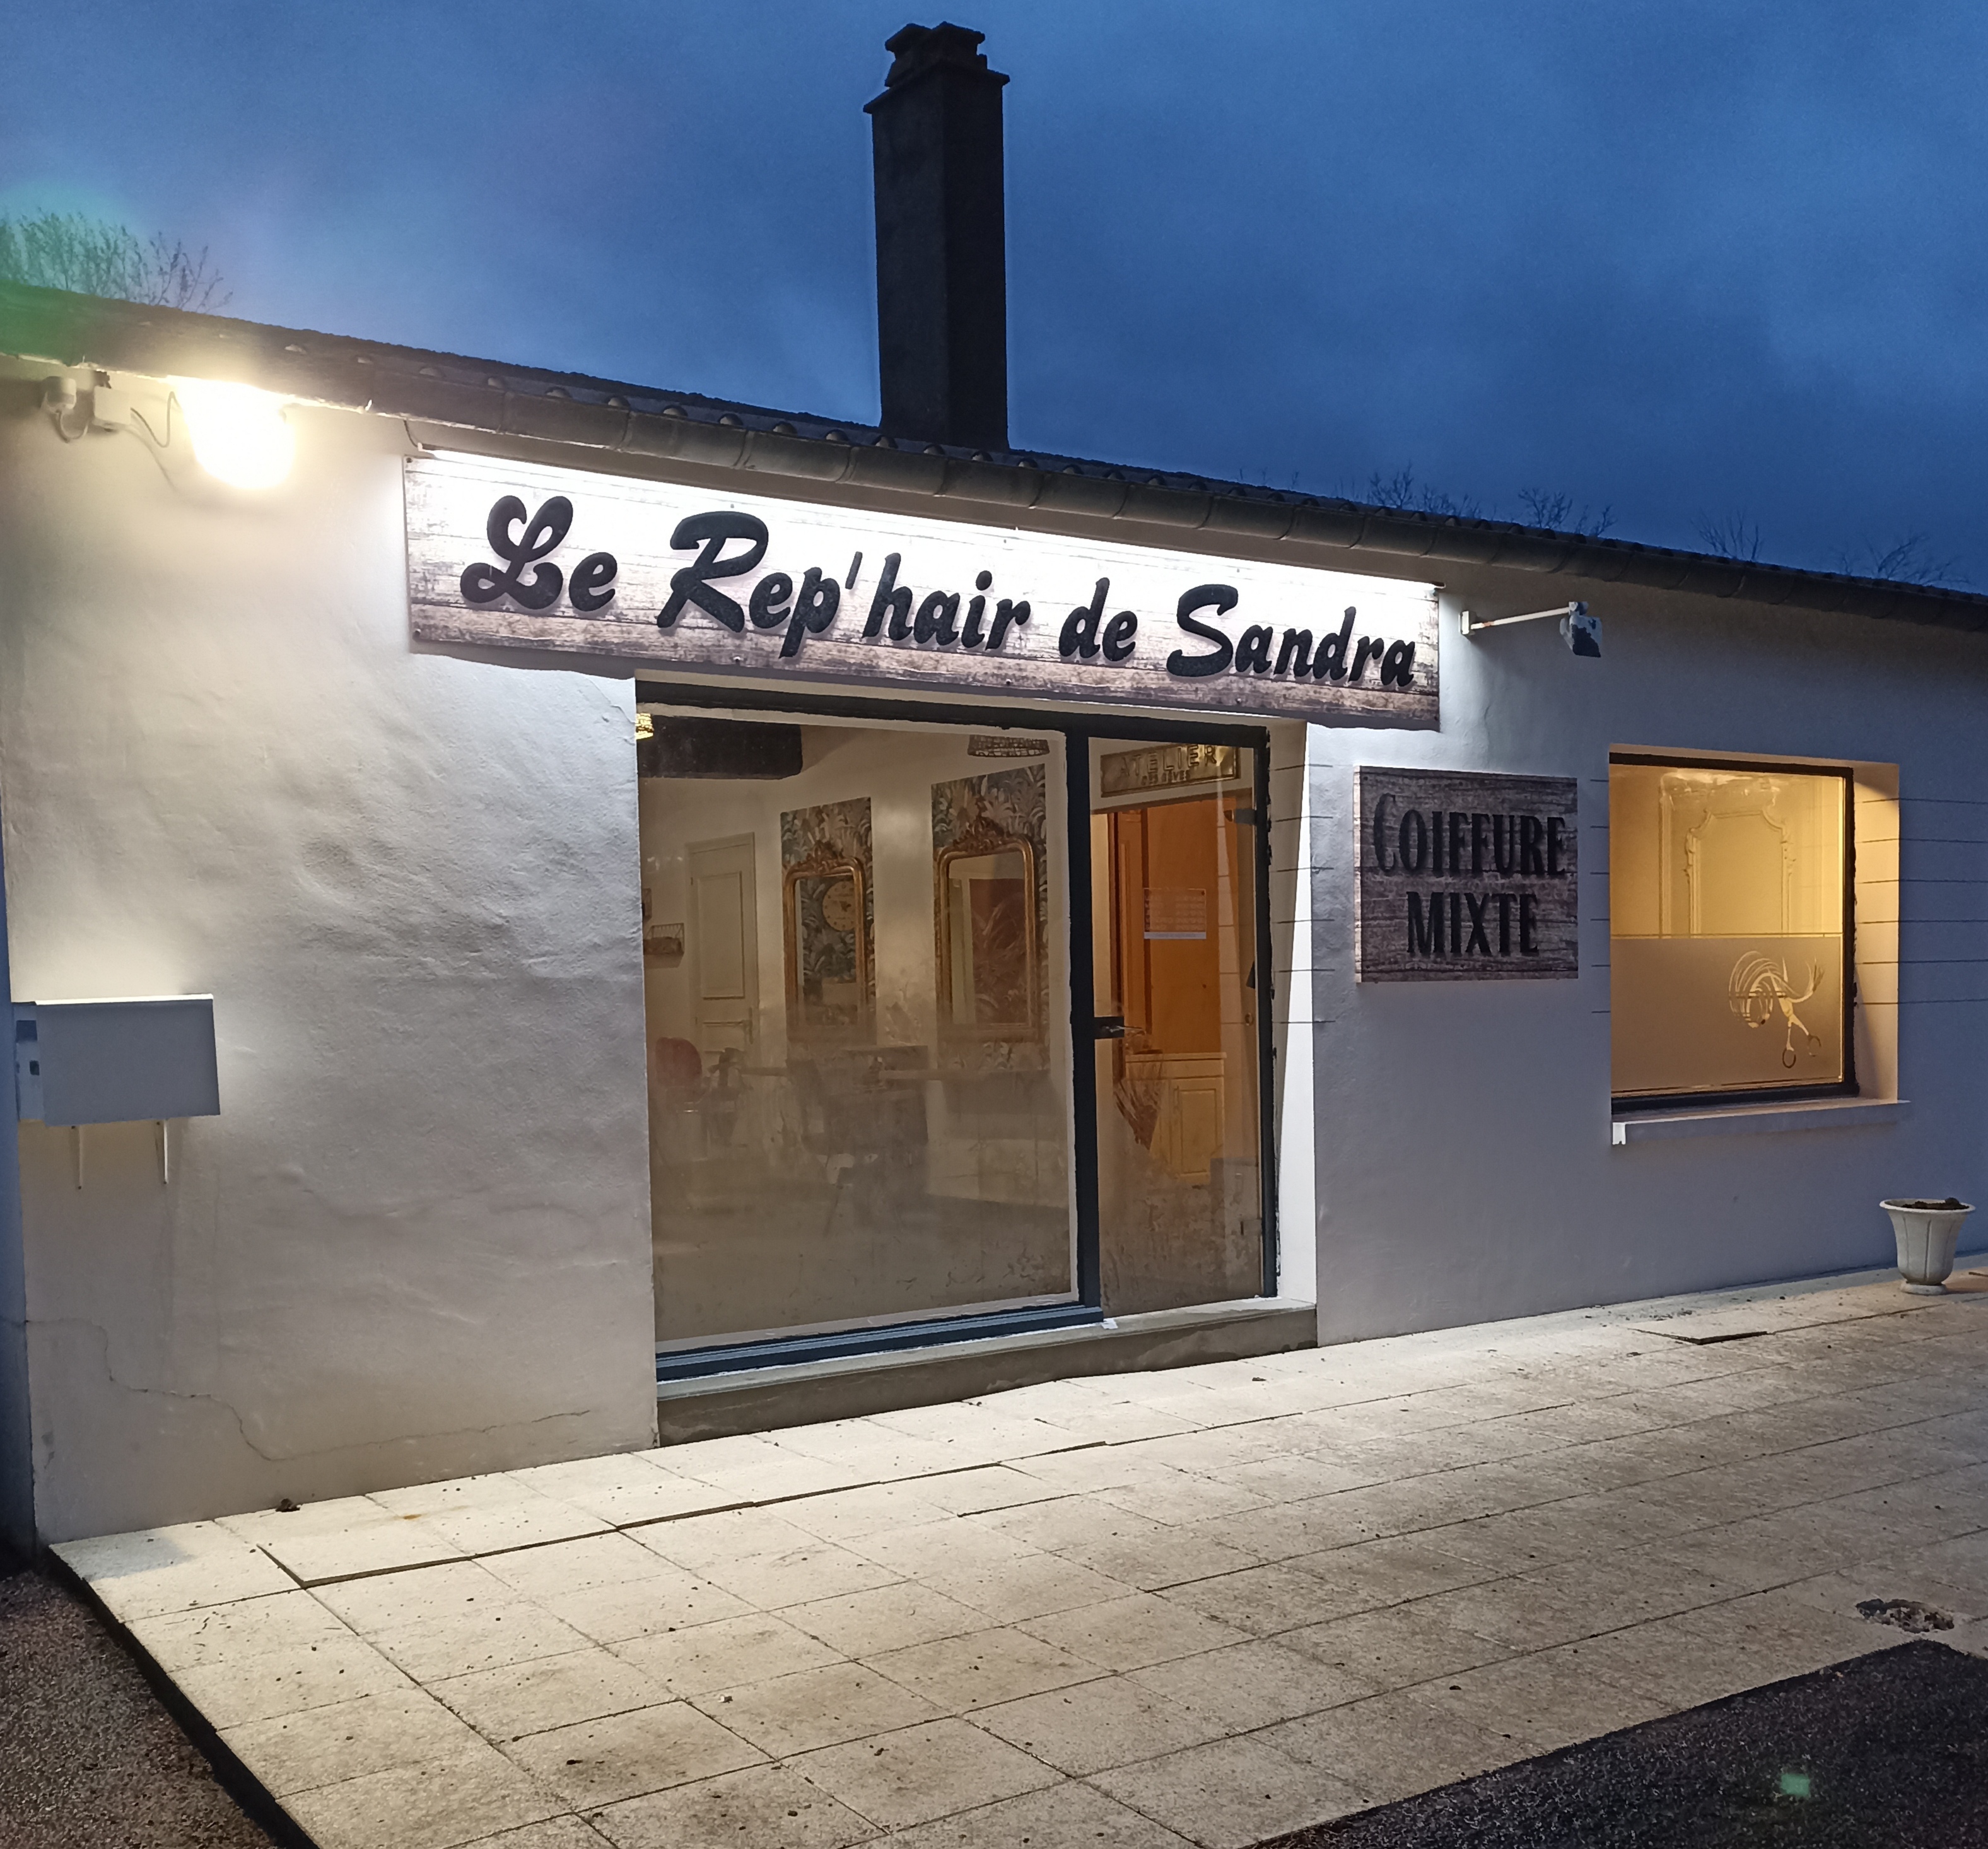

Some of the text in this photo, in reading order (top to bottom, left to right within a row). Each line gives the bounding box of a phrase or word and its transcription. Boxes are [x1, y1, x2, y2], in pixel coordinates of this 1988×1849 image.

[460, 495, 1416, 688] Le Rep'hair de Sandra
[1120, 744, 1217, 777] ATELIER
[1373, 792, 1566, 877] COIFFURE
[1406, 891, 1540, 957] MIXTE
